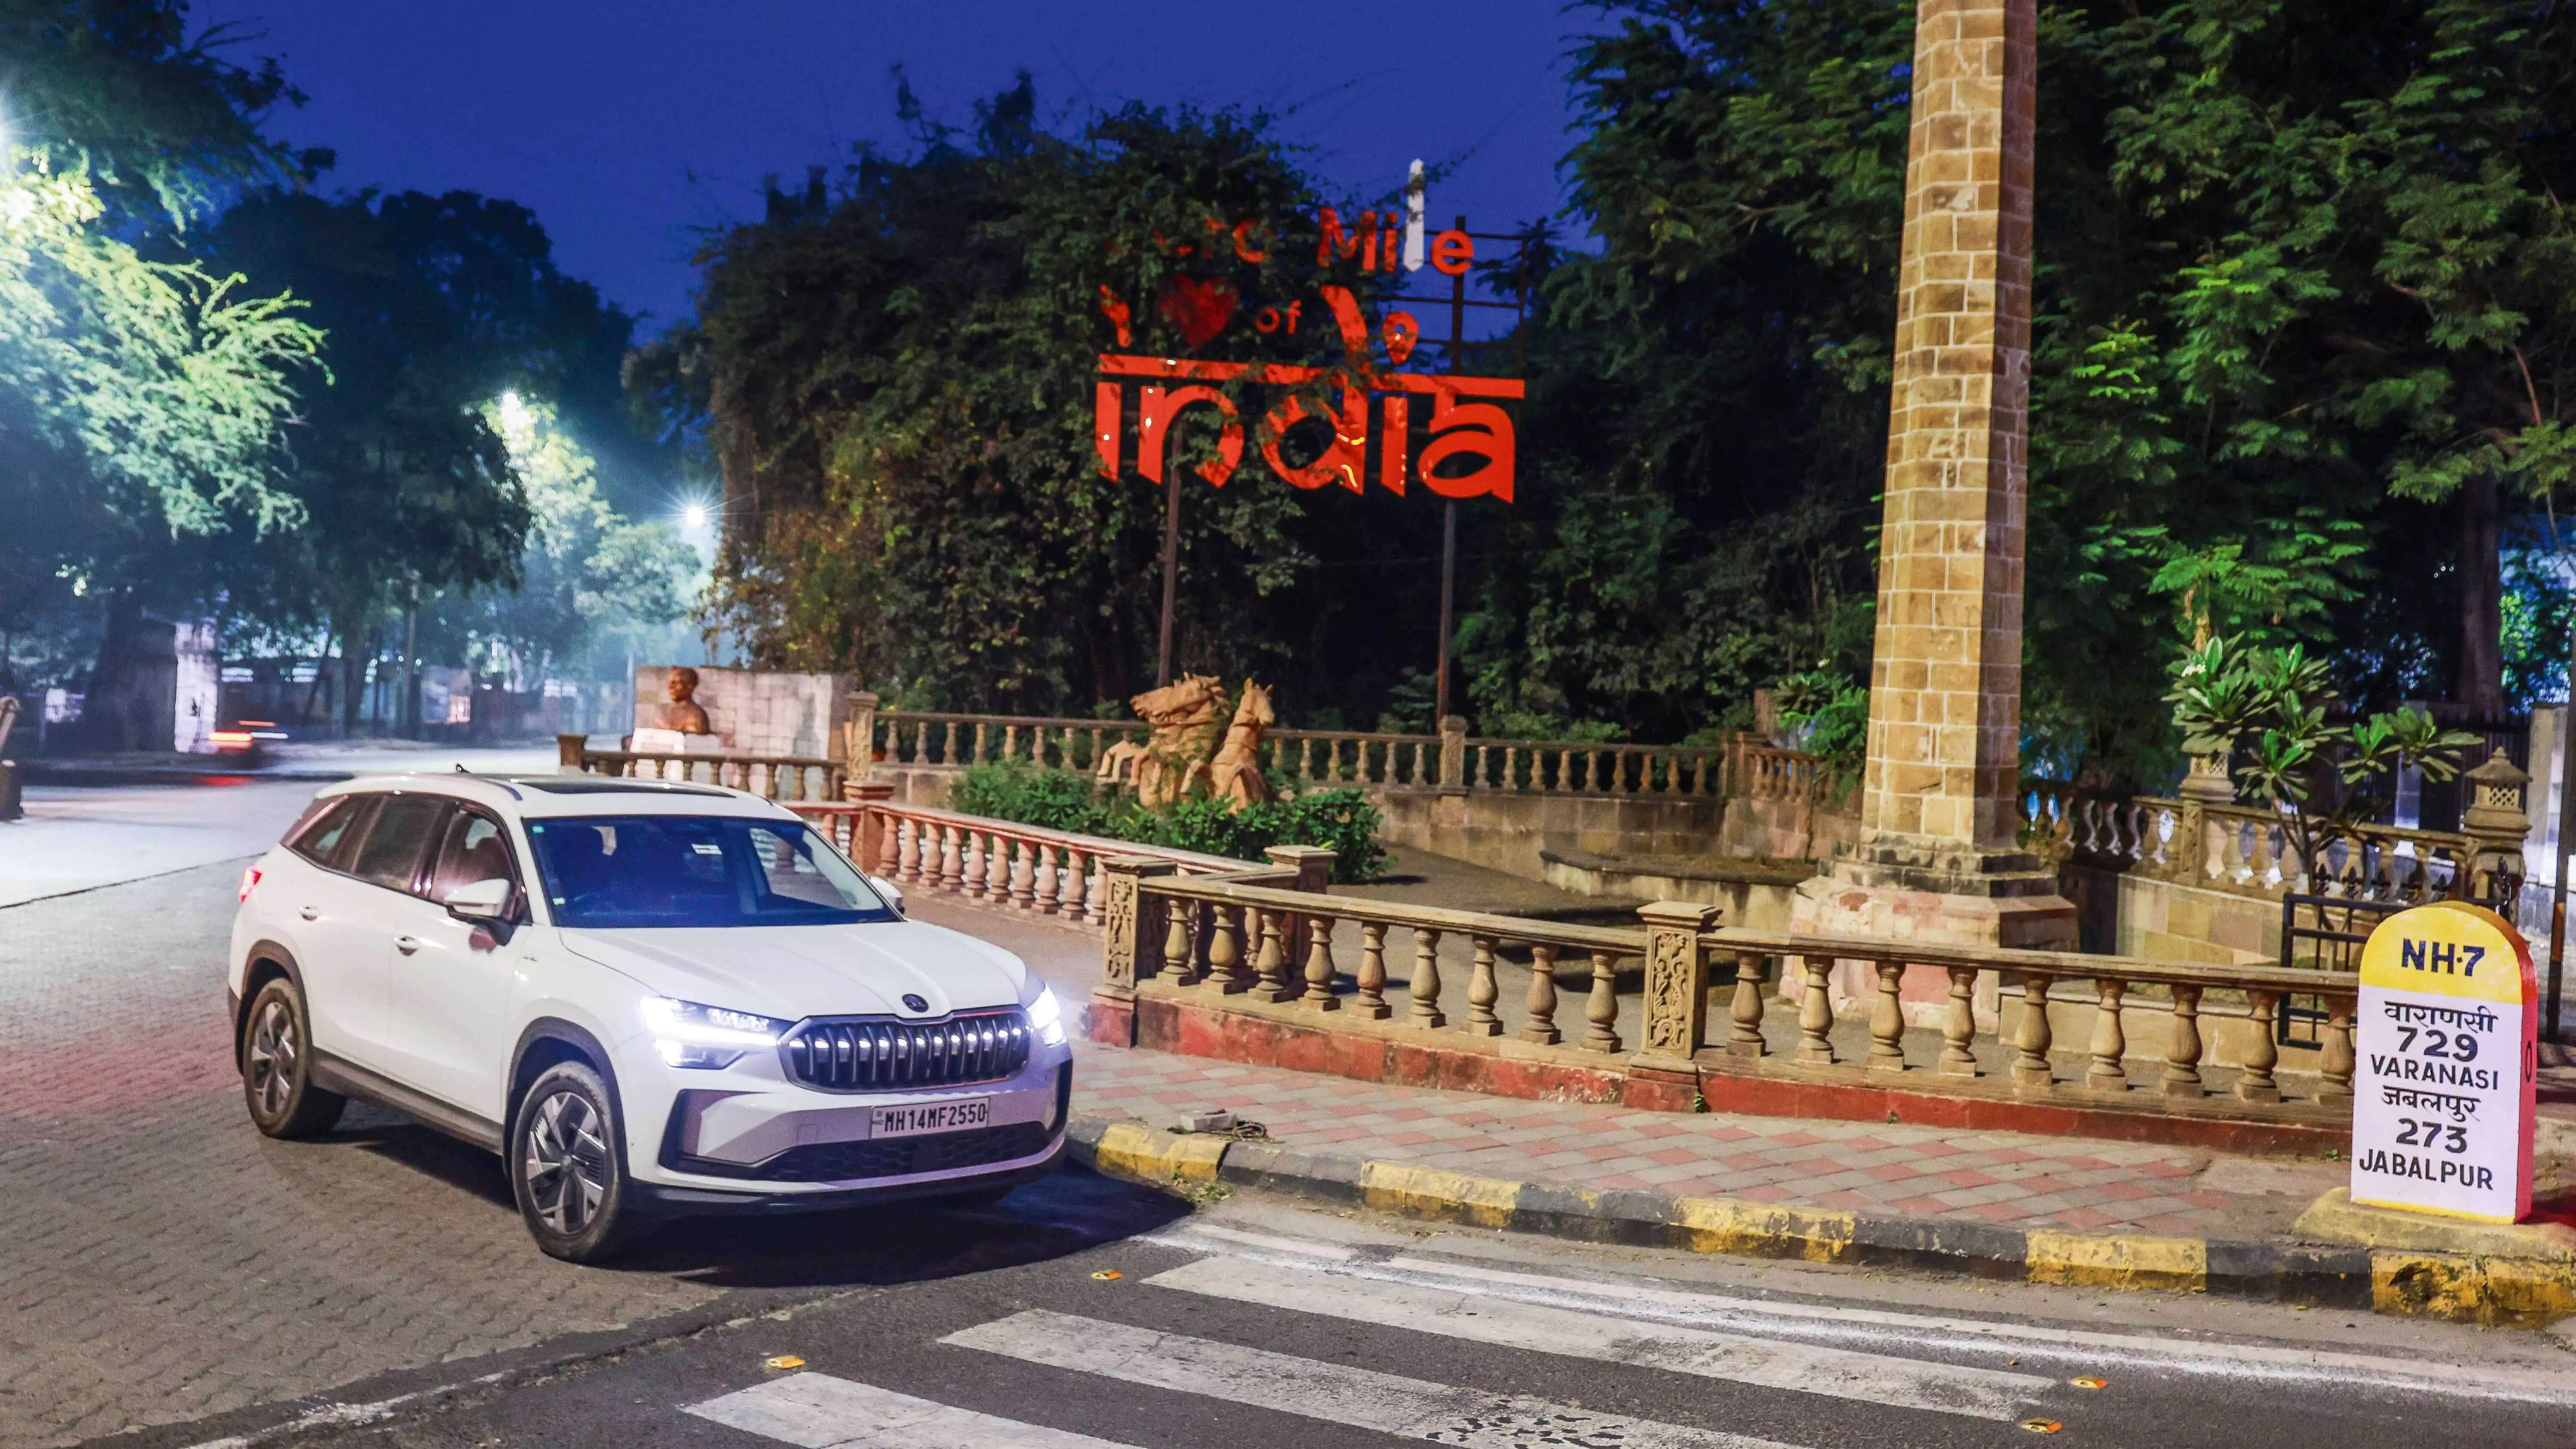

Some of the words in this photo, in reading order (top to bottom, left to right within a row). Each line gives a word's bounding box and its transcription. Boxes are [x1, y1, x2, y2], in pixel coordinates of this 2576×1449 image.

[1317, 158, 1475, 275] Mile
[1255, 299, 1302, 334] of
[2384, 1000, 2499, 1033] वाराणसी
[2397, 1025, 2479, 1063] 729
[2370, 1054, 2498, 1091] VARANASI
[884, 1103, 987, 1132] MH14MF2550
[2381, 1084, 2482, 1122] जबलपुर
[2395, 1118, 2468, 1154] 273
[2359, 1148, 2494, 1191] JABALPUR
